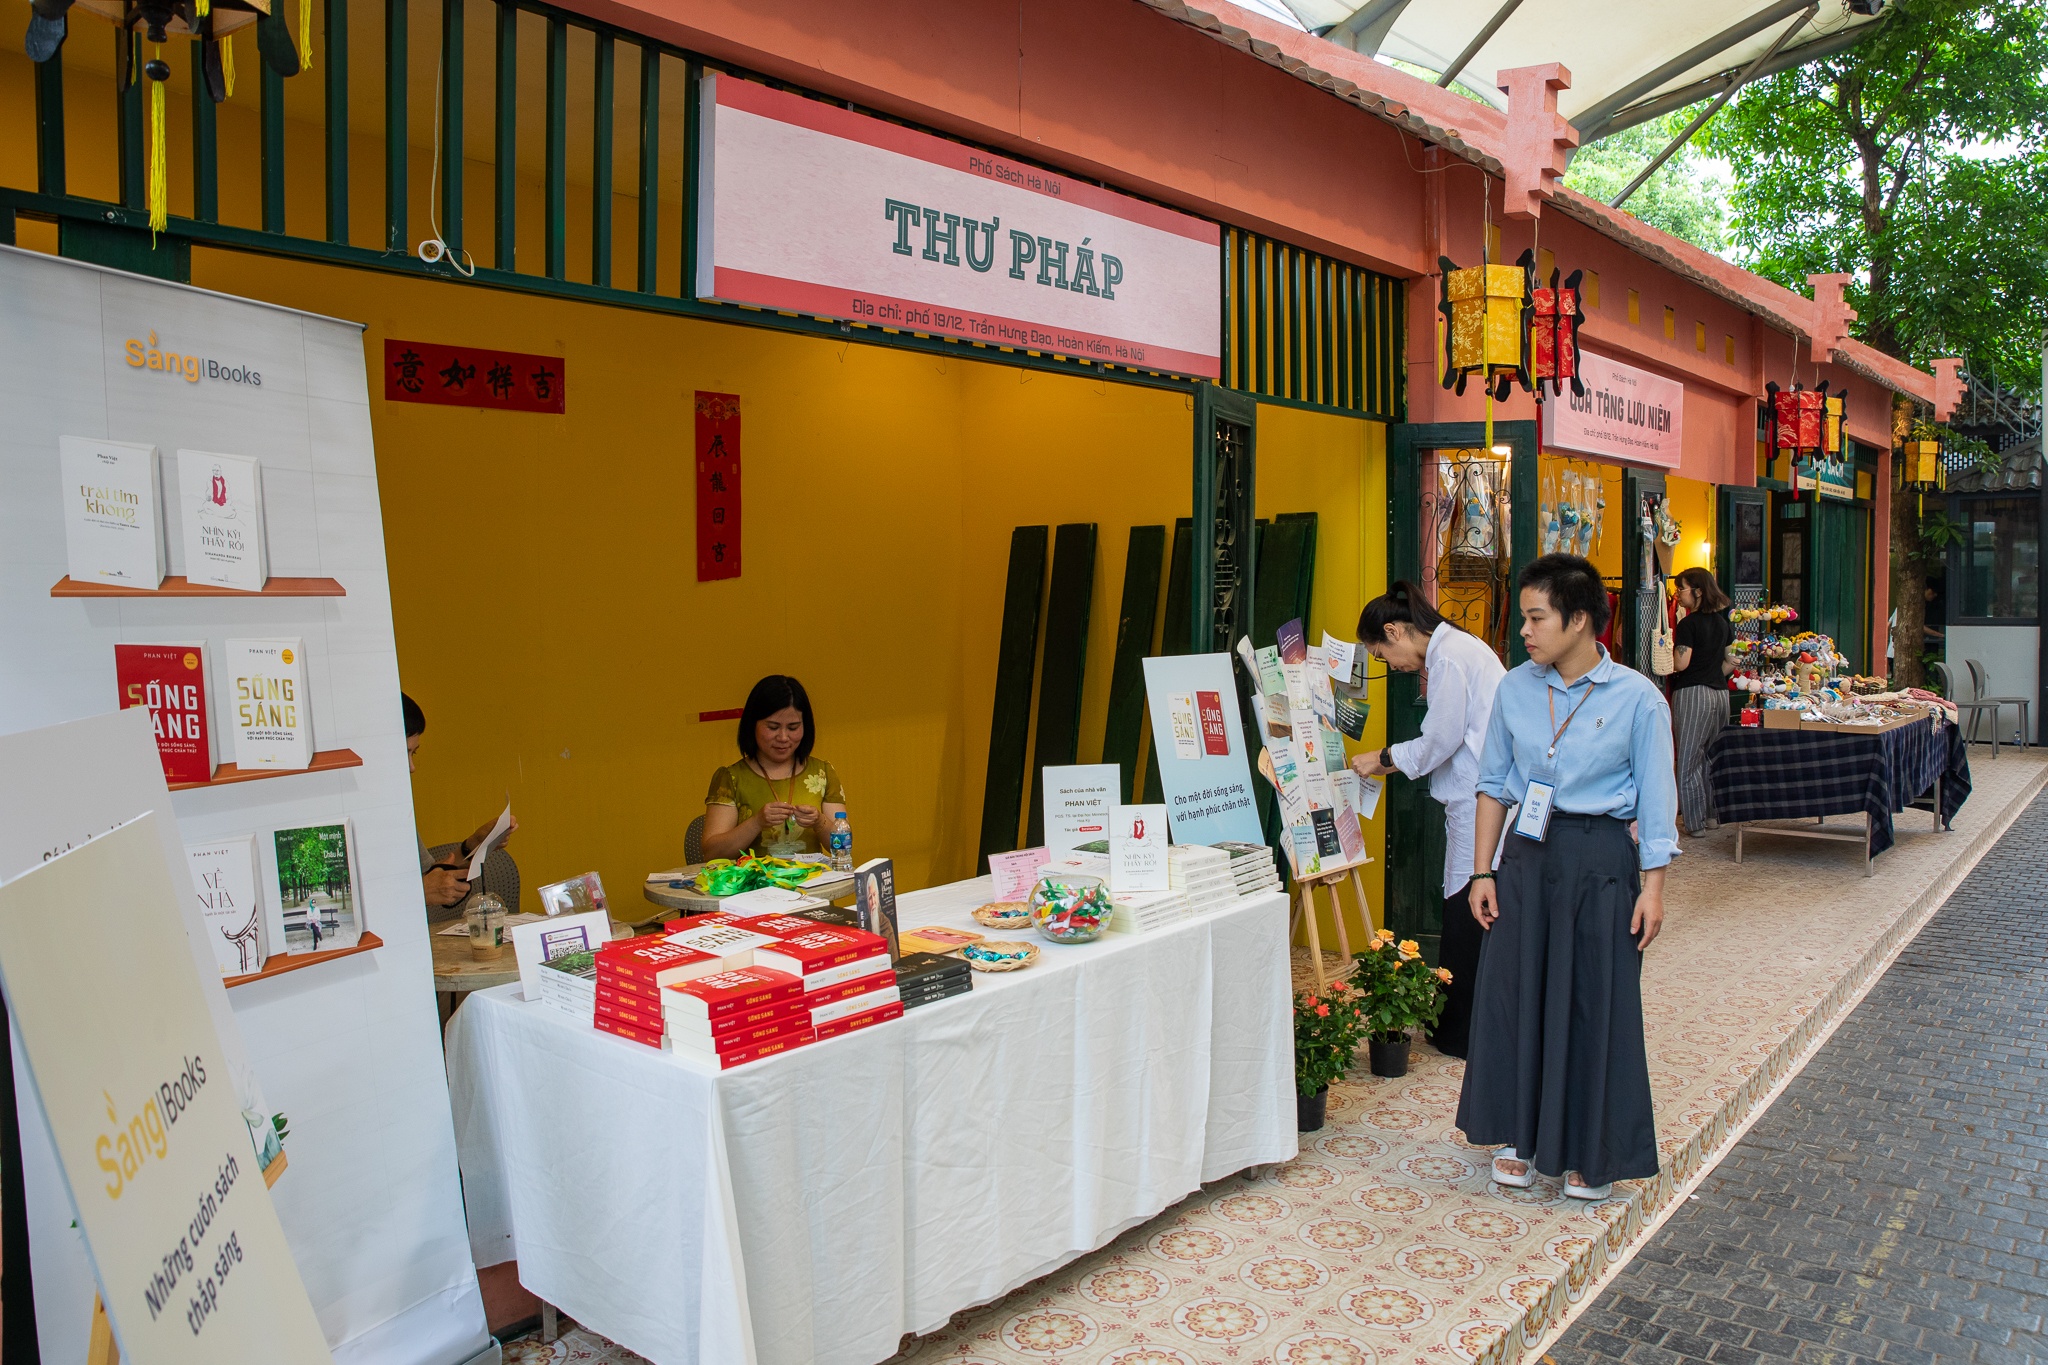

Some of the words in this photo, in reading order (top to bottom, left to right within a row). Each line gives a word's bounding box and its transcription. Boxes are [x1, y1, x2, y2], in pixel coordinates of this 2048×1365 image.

[969, 156, 992, 177] Phố
[995, 163, 1025, 184] Sách
[1027, 170, 1042, 188] Hà
[1044, 176, 1061, 196] Nội
[885, 198, 1000, 273] THƯ
[1008, 229, 1124, 300] PHÁP
[852, 299, 874, 318] Địa
[878, 303, 902, 321] chỉ:
[906, 307, 930, 326] phố
[933, 312, 965, 332] 19/12,
[969, 317, 995, 336] Trần
[999, 324, 1028, 343] Hưng
[1031, 329, 1054, 347] Đạo,
[1057, 335, 1083, 351] Hoàn
[1087, 339, 1113, 356] Kiếm,
[1115, 345, 1128, 358] Hà
[1130, 348, 1145, 361] Nội
[208, 358, 262, 387] Books
[1596, 388, 1624, 424] TẶNG
[1648, 404, 1671, 437] NIỆM
[127, 679, 198, 710] SỐNG
[236, 673, 294, 702] SỐNG
[152, 710, 200, 739] ÁNG
[239, 702, 296, 728] SÁNG
[1086, 798, 1102, 806] VIỆT
[1174, 795, 1187, 806] Cho
[1188, 792, 1202, 804] một
[1202, 788, 1213, 800] đời
[1214, 786, 1228, 797] sống
[1229, 784, 1245, 794] sáng,
[1176, 811, 1187, 822] với
[1188, 808, 1204, 820] hạnh
[1206, 804, 1221, 818] phúc
[1222, 800, 1236, 812] chân
[1238, 796, 1250, 808] thật
[159, 1055, 207, 1125] Books
[144, 1234, 194, 1322] Những
[188, 1193, 218, 1247] cuốn
[214, 1152, 240, 1204] sách
[186, 1278, 218, 1336] thắp
[213, 1229, 243, 1285] sáng
